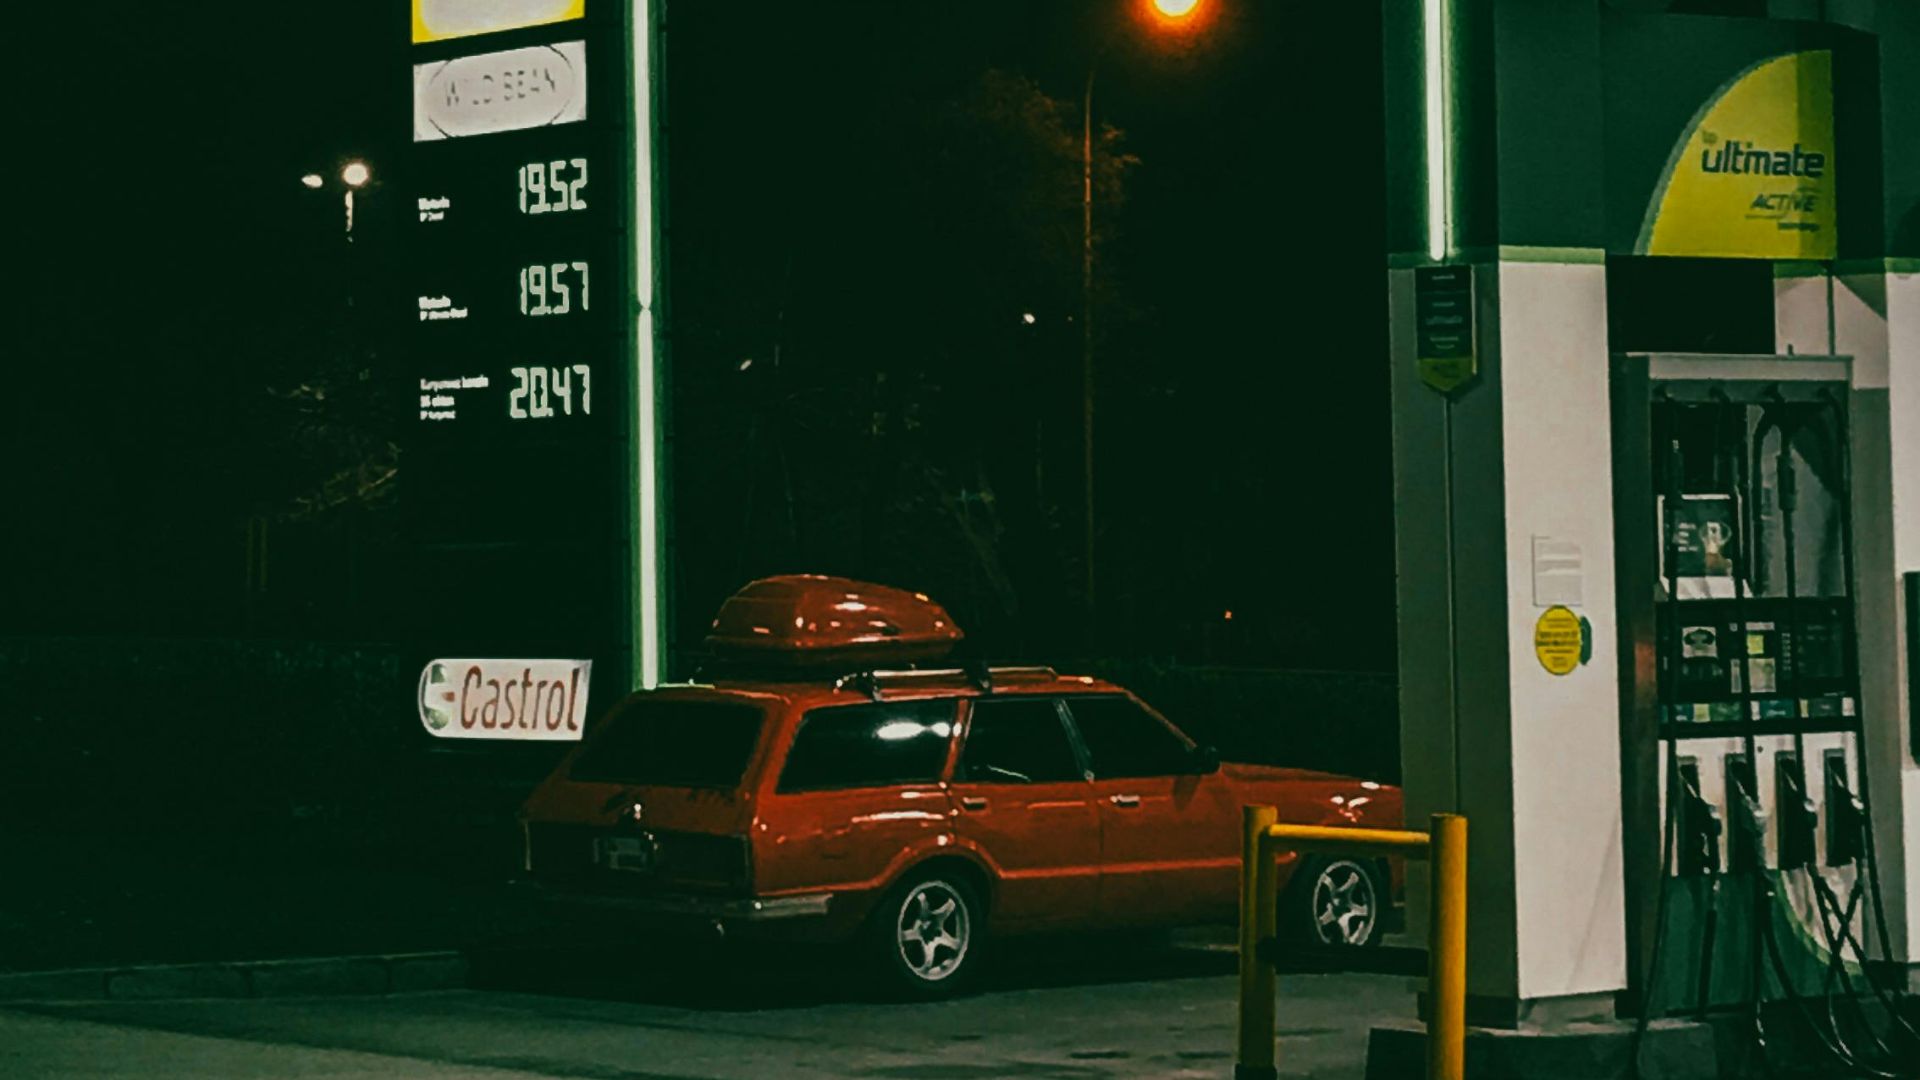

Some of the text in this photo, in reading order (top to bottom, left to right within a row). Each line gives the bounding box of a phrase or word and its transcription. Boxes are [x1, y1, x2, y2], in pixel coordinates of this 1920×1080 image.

[443, 73, 495, 107] WLD
[1701, 139, 1825, 177] ultimate
[1750, 192, 1818, 212] ACTIVE
[509, 364, 591, 419] 20.47
[461, 665, 581, 731] Castrol
